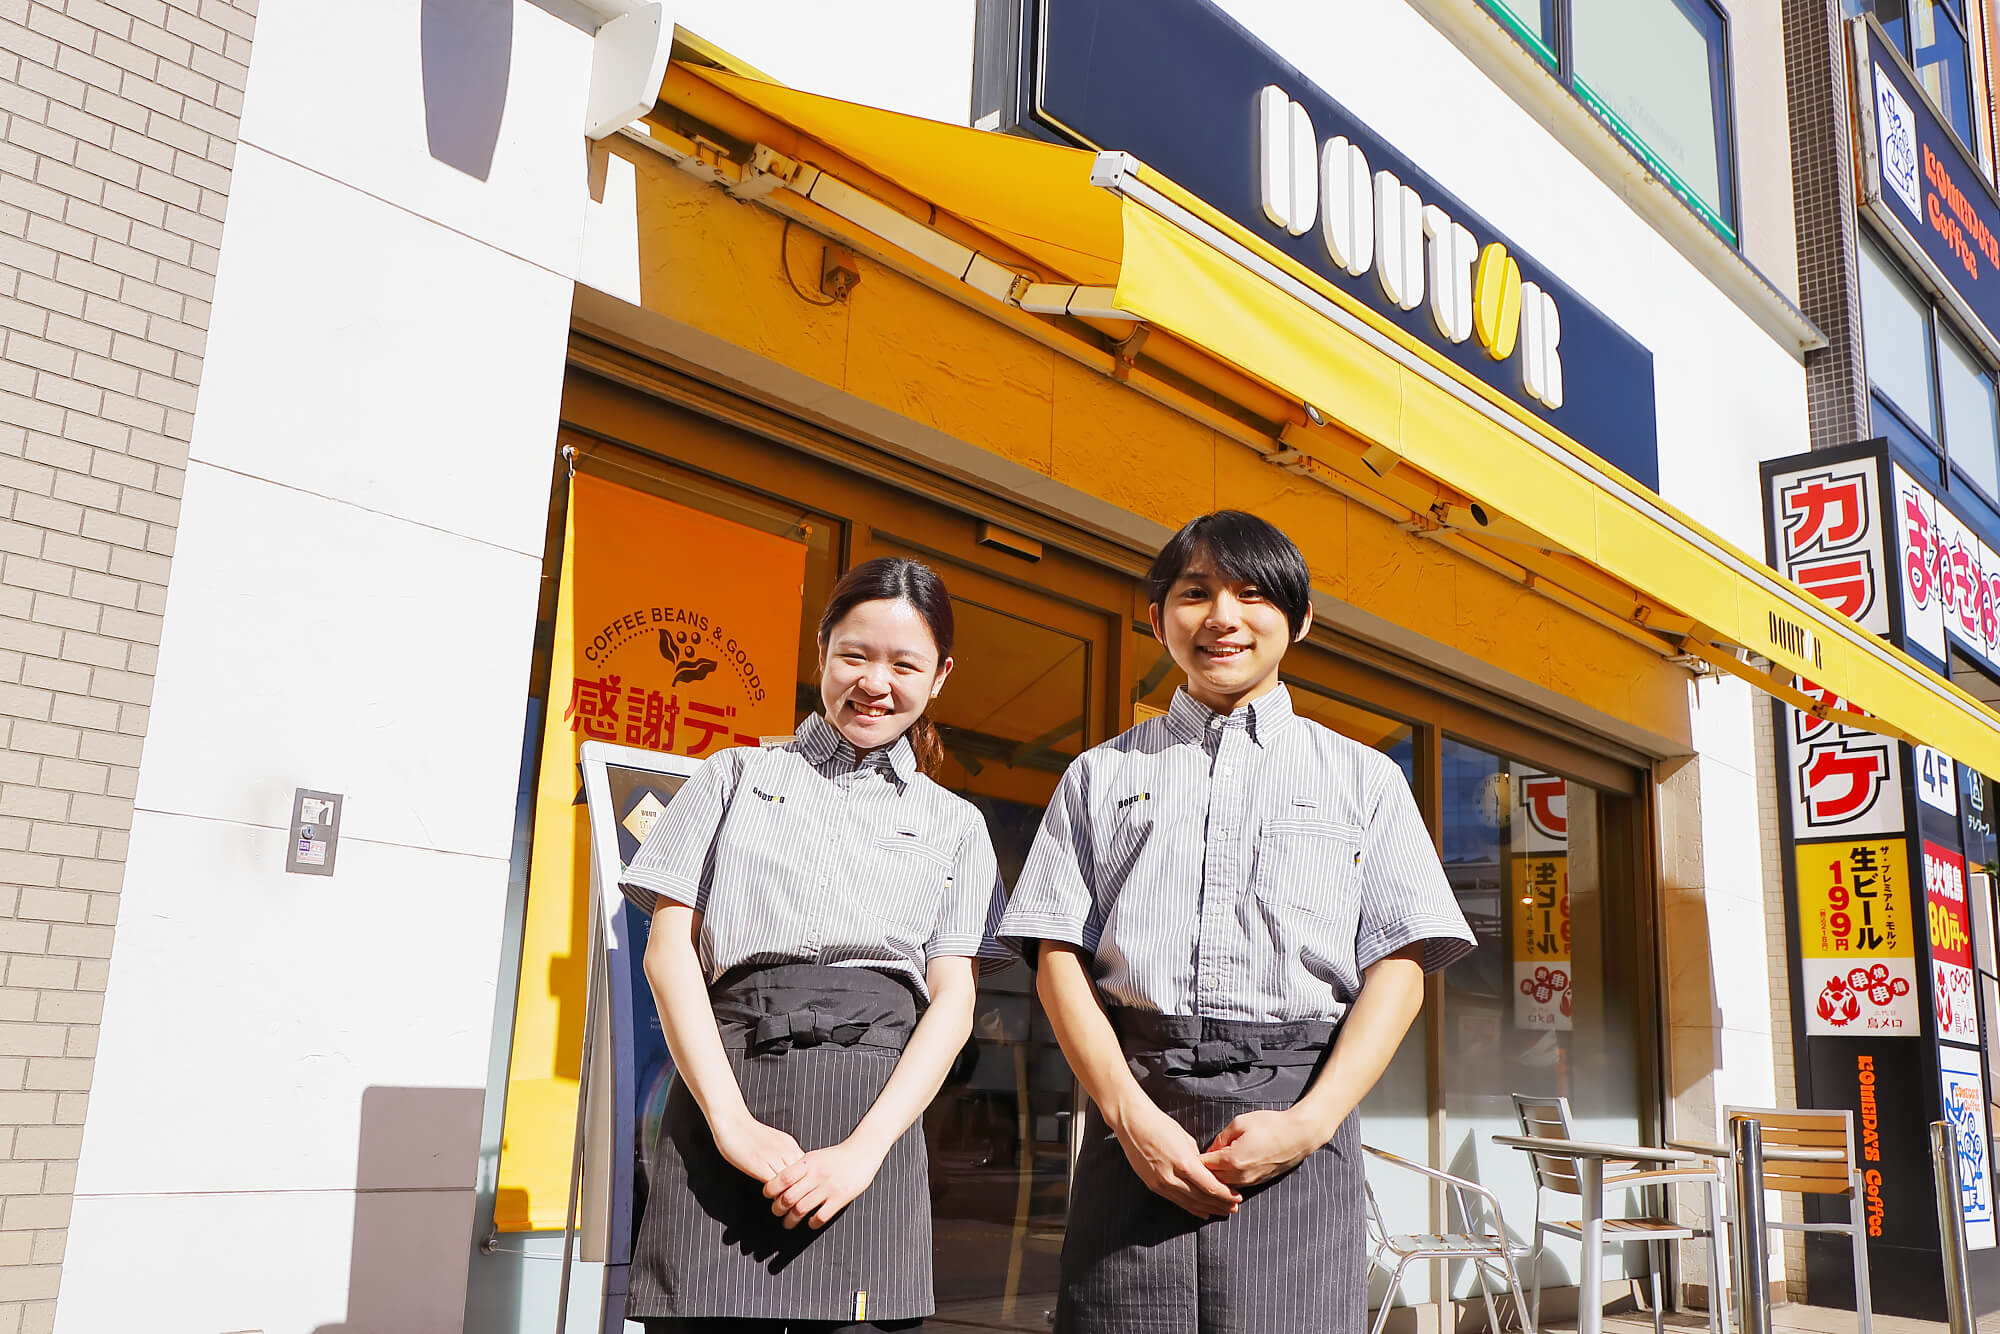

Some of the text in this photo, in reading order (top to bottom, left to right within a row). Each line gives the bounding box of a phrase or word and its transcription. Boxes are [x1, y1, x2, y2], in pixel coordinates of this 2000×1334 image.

[1260, 83, 1564, 411] DOUTOR
[1928, 192, 1978, 281] Coffee
[585, 607, 766, 701] COFFEE BEANS & GOODS
[1923, 749, 1949, 798] 4F
[1828, 860, 1852, 952] 199円
[1850, 846, 1884, 951] 生ビール
[1858, 1055, 1885, 1237] KOMEDA'S Coffee
